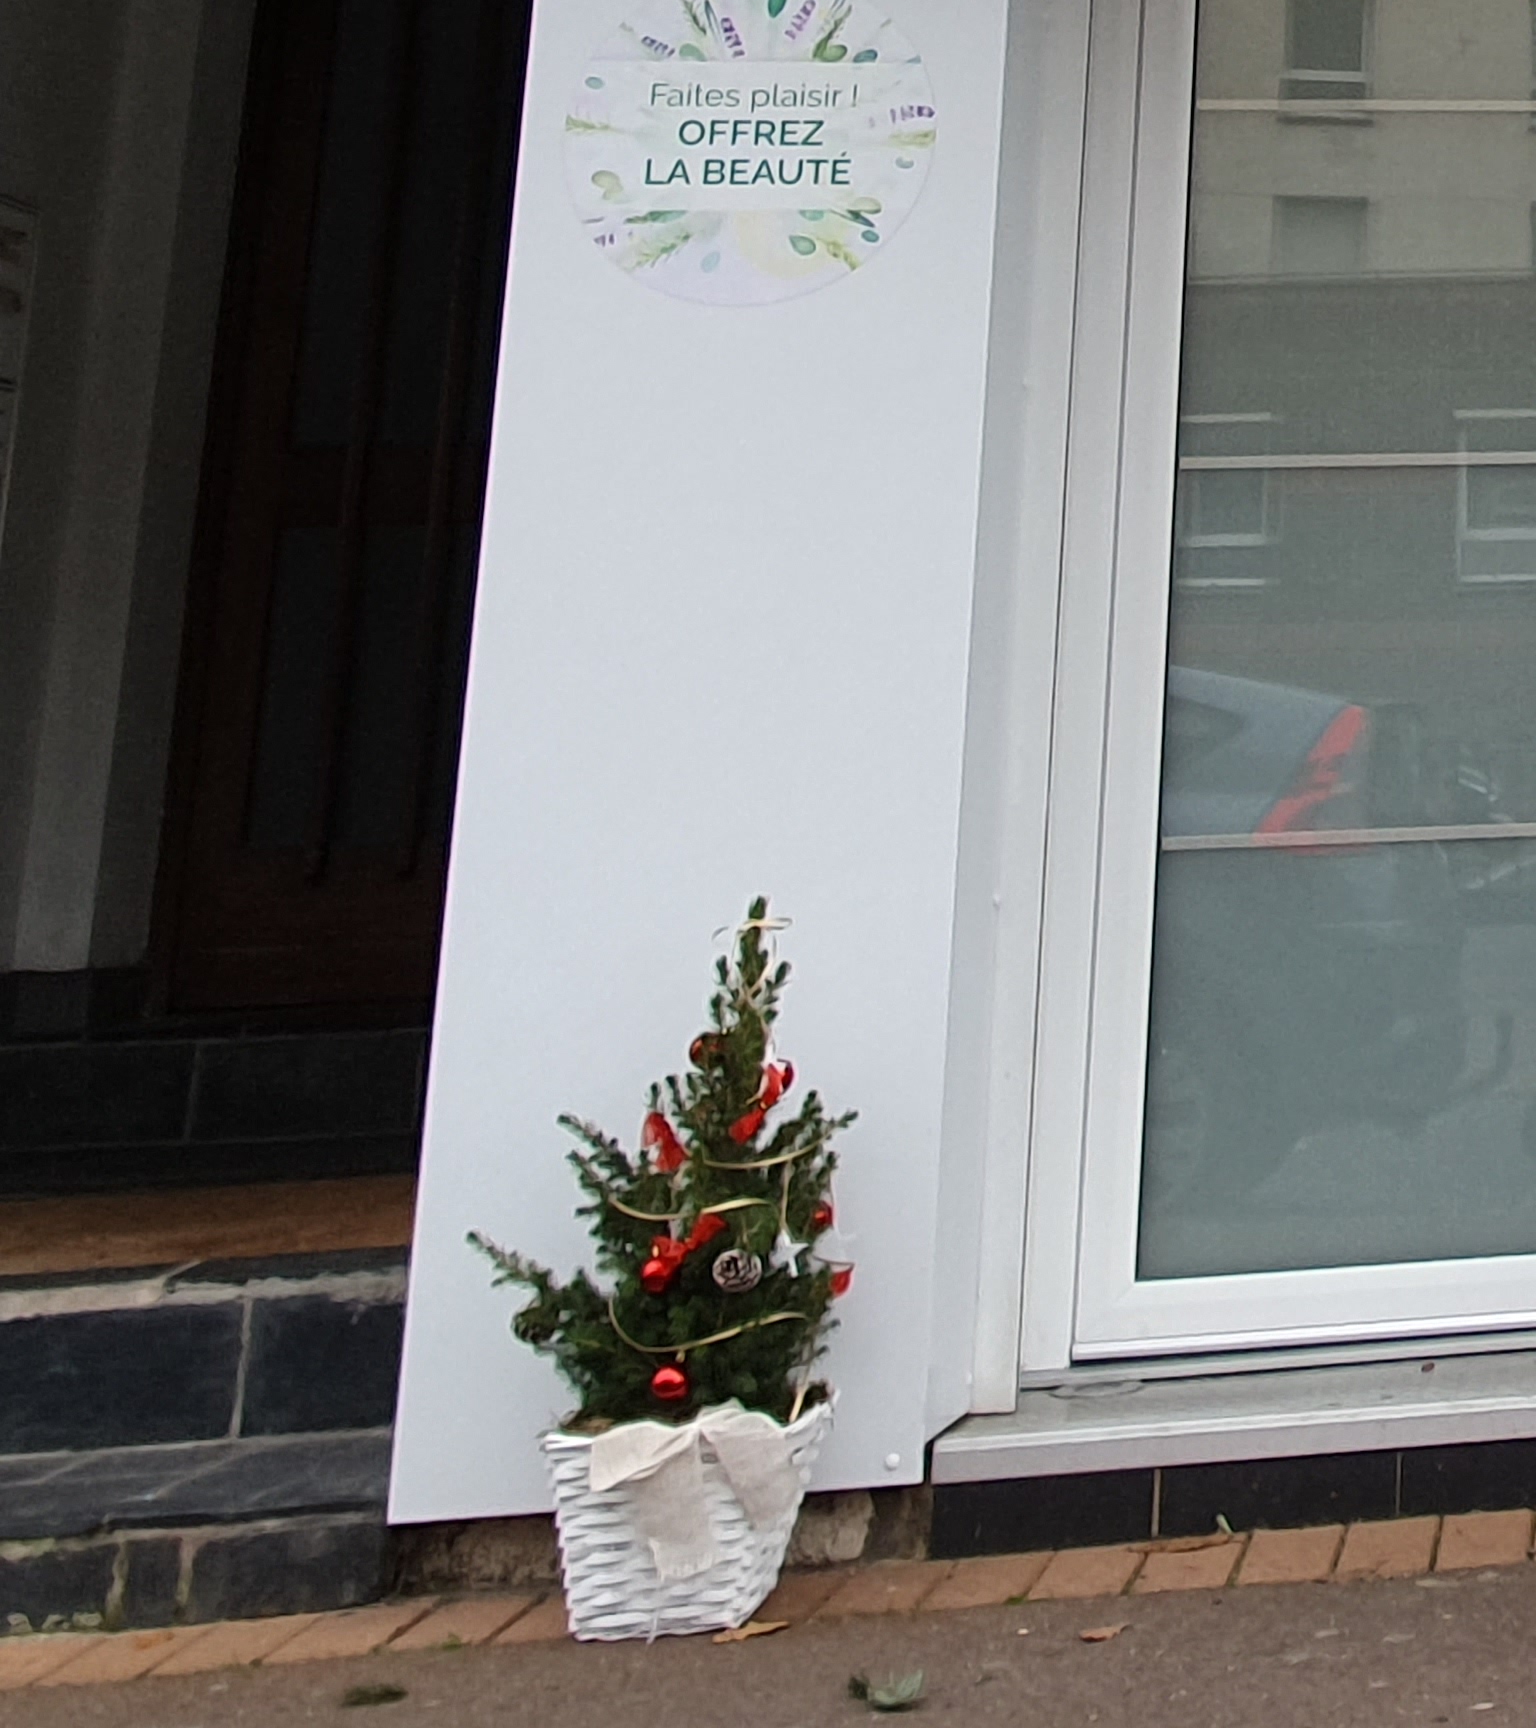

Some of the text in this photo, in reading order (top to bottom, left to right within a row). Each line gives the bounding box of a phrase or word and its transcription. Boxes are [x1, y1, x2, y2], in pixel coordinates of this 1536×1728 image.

[649, 82, 741, 108] Faites
[750, 82, 842, 114] plaisir
[678, 119, 825, 147] OFFREZ
[643, 151, 853, 186] LA BEAUTÉ
